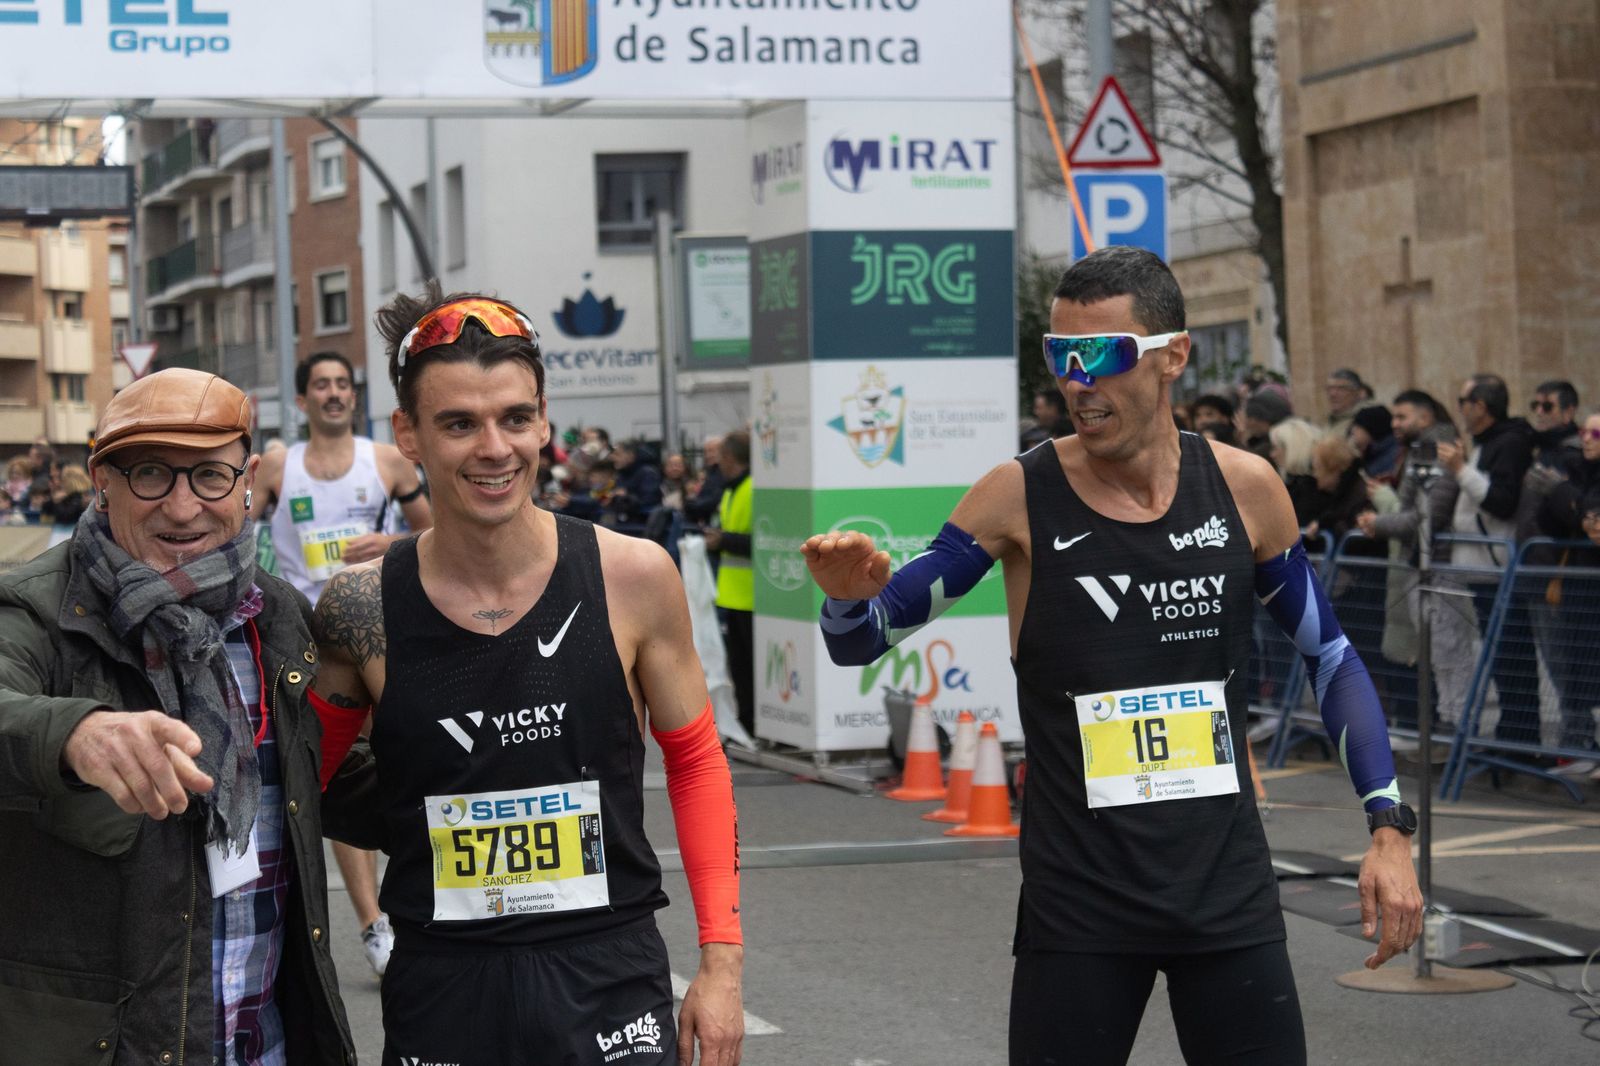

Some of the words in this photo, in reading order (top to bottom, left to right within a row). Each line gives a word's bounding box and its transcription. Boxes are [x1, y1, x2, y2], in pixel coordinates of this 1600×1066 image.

[108, 29, 230, 57] Grupo
[615, 25, 666, 62] de
[688, 25, 920, 63] Salamanca
[1089, 183, 1148, 249] P
[1168, 532, 1194, 552] be
[1192, 515, 1229, 549] plus
[323, 541, 340, 560] 10
[1139, 574, 1226, 604] VICKY
[1151, 600, 1222, 621] FOODS
[1160, 628, 1220, 642] ATHLETICS
[1119, 689, 1213, 714] SETEL
[491, 702, 567, 732] VICKY
[501, 724, 562, 747] FOODS
[1132, 717, 1170, 763] 16
[1141, 761, 1167, 773] DUPI
[1154, 778, 1195, 789] Ayuntamiento
[1155, 789, 1163, 797] de
[1164, 788, 1196, 798] Salamanca
[471, 791, 582, 821] SETEL
[452, 821, 561, 877] 5789
[482, 873, 532, 887] SANCHEZ
[506, 892, 554, 904] Ayuntamiento
[508, 905, 516, 913] de
[517, 902, 555, 912] Salamanca
[596, 1032, 623, 1052] be
[622, 1012, 661, 1045] plus
[604, 1048, 631, 1063] NATURAL
[633, 1045, 663, 1053] LIFESTYLE
